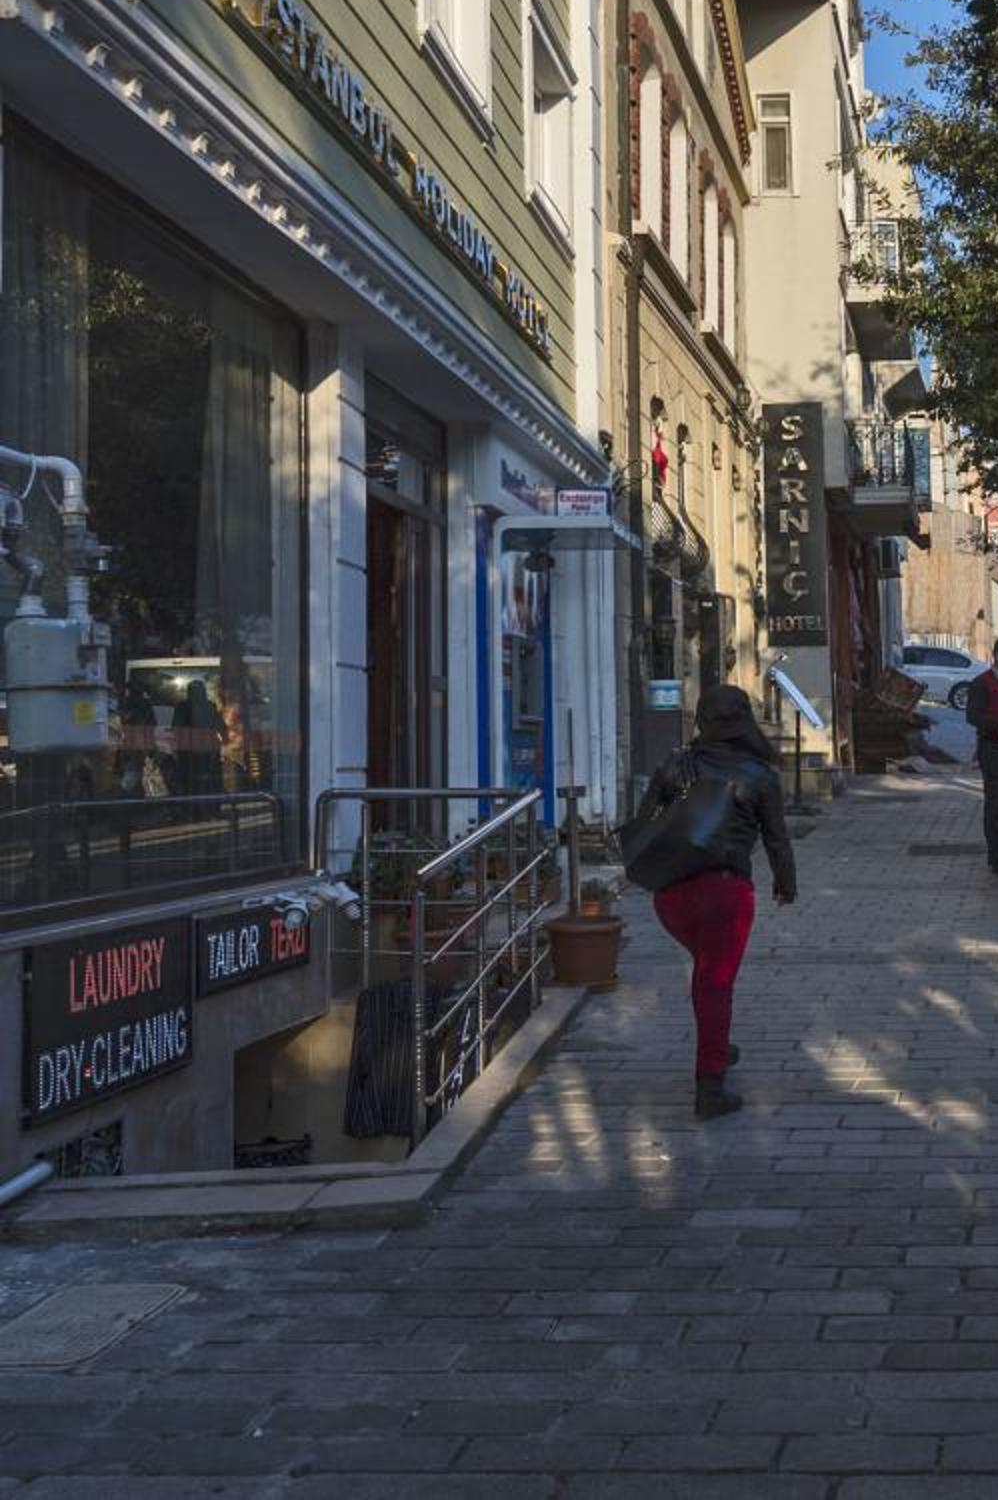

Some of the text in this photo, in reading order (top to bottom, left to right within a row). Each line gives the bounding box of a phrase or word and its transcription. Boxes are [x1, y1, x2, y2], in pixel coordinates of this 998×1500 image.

[415, 162, 496, 279] HOLIDAY
[769, 614, 824, 632] HOTEL
[69, 936, 167, 1013] LAUNDRY
[207, 924, 260, 980] TAILOR
